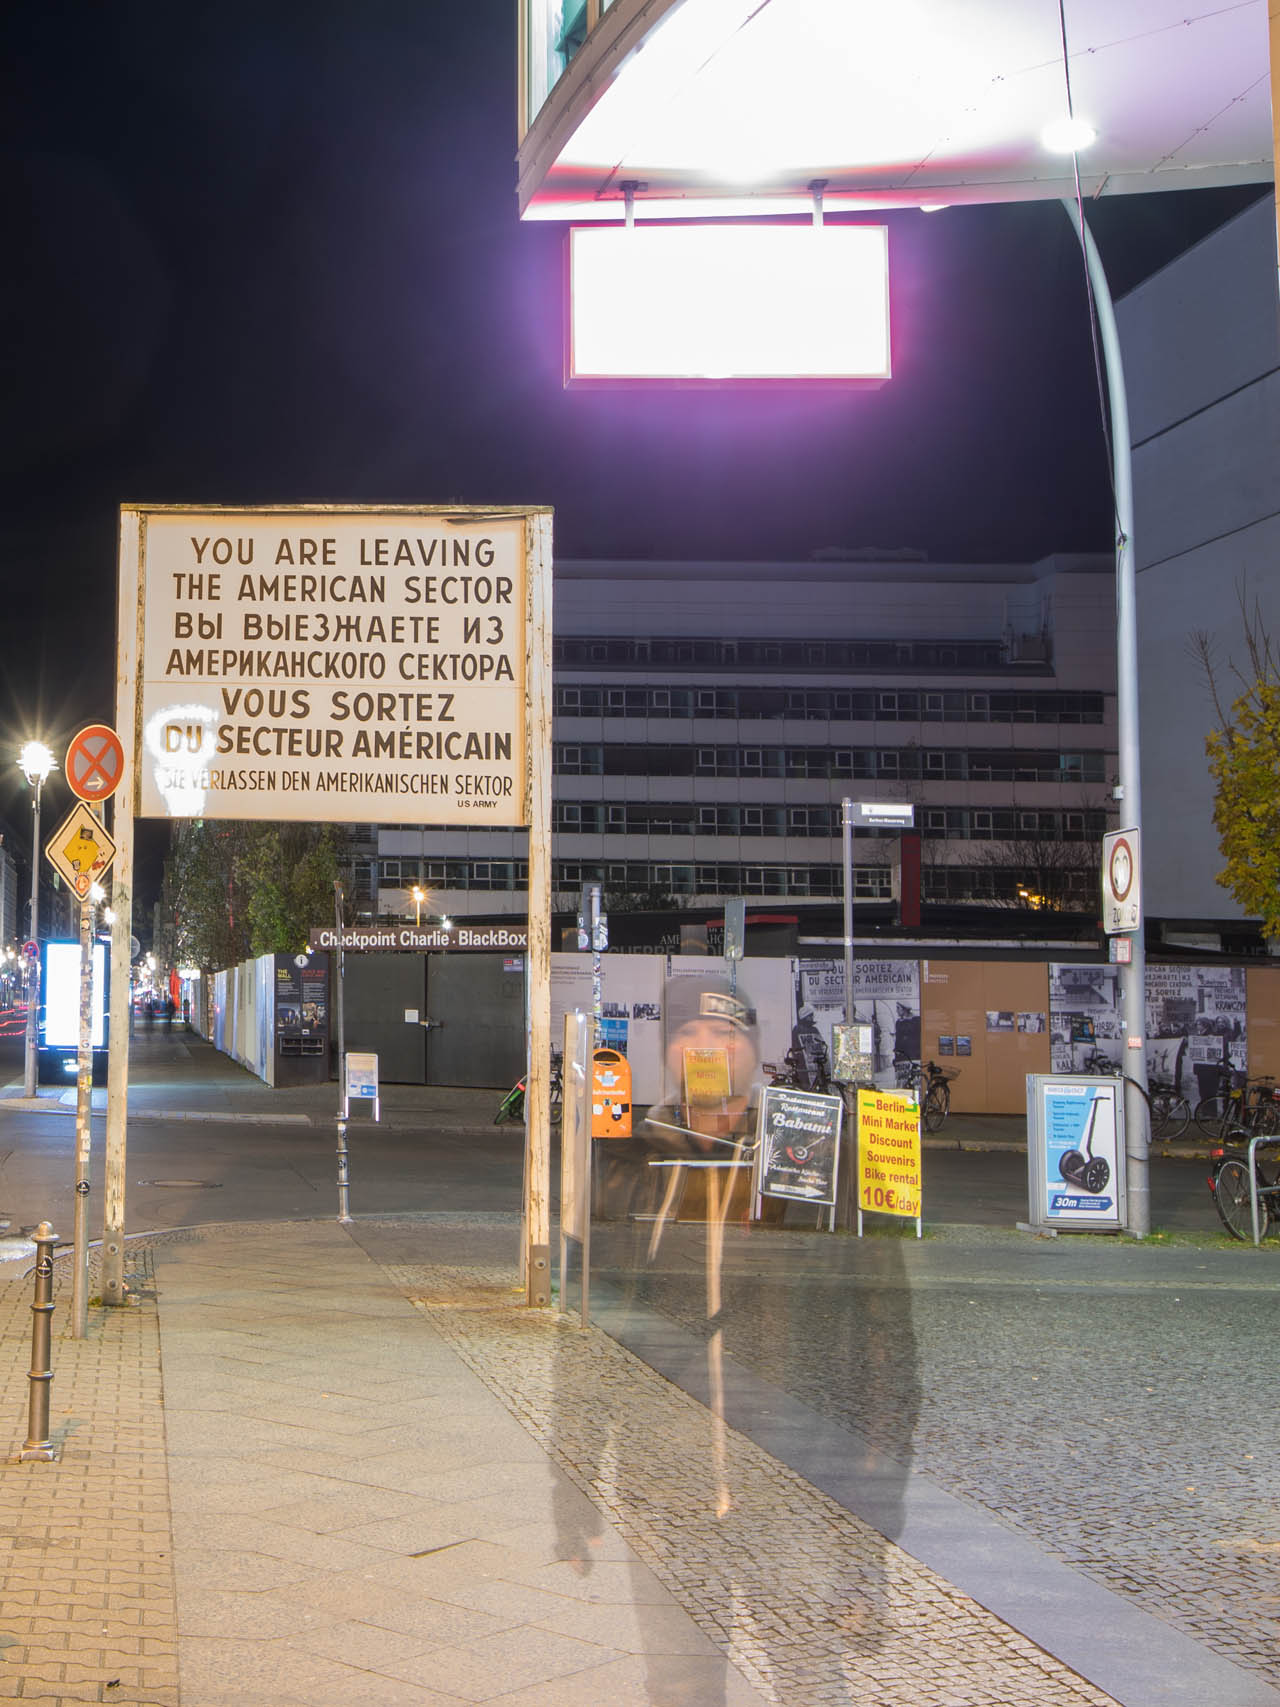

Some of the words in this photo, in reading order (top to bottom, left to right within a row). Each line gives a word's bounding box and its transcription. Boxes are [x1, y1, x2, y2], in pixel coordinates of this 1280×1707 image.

[190, 537, 254, 565] YOU
[275, 538, 336, 566] ARE
[360, 538, 495, 567] LEAVING
[173, 572, 221, 601] THE
[237, 574, 385, 603] AMERICAN
[405, 575, 513, 605] SECTOR
[174, 612, 223, 640] ВЫ
[243, 613, 440, 644] ВЫЕЗЖАЕТЕ
[463, 616, 504, 645] ИЗ
[165, 649, 386, 679] АМЕРИКАНСКОГО
[398, 653, 515, 681] СЕКТОРА
[221, 688, 311, 719] VOUS
[329, 691, 455, 722] SORTEZ
[166, 725, 203, 753] DU
[216, 725, 344, 758] SECTEUR
[351, 726, 512, 761] AMÉRICAIN
[192, 768, 277, 791] VERLASSEN
[282, 770, 310, 791] DEN
[315, 771, 449, 795] AMERIKANISCHEN
[455, 774, 513, 797] SEKTOR
[457, 799, 470, 808] US
[472, 800, 498, 808] ARMY
[320, 931, 397, 950] Checkpoint
[400, 930, 449, 946] Charlie
[458, 930, 528, 946] BlackBox
[824, 974, 861, 985] SECTR
[876, 1099, 905, 1113] Berlin
[862, 1115, 882, 1127] Mini
[885, 1117, 918, 1132] Market
[869, 1133, 912, 1149] Discount
[867, 1150, 916, 1168] Souvenirs
[864, 1167, 887, 1182] Bike
[889, 1170, 918, 1185] rental
[863, 1186, 919, 1216] 10€/day
[1055, 1197, 1077, 1207] 30m
